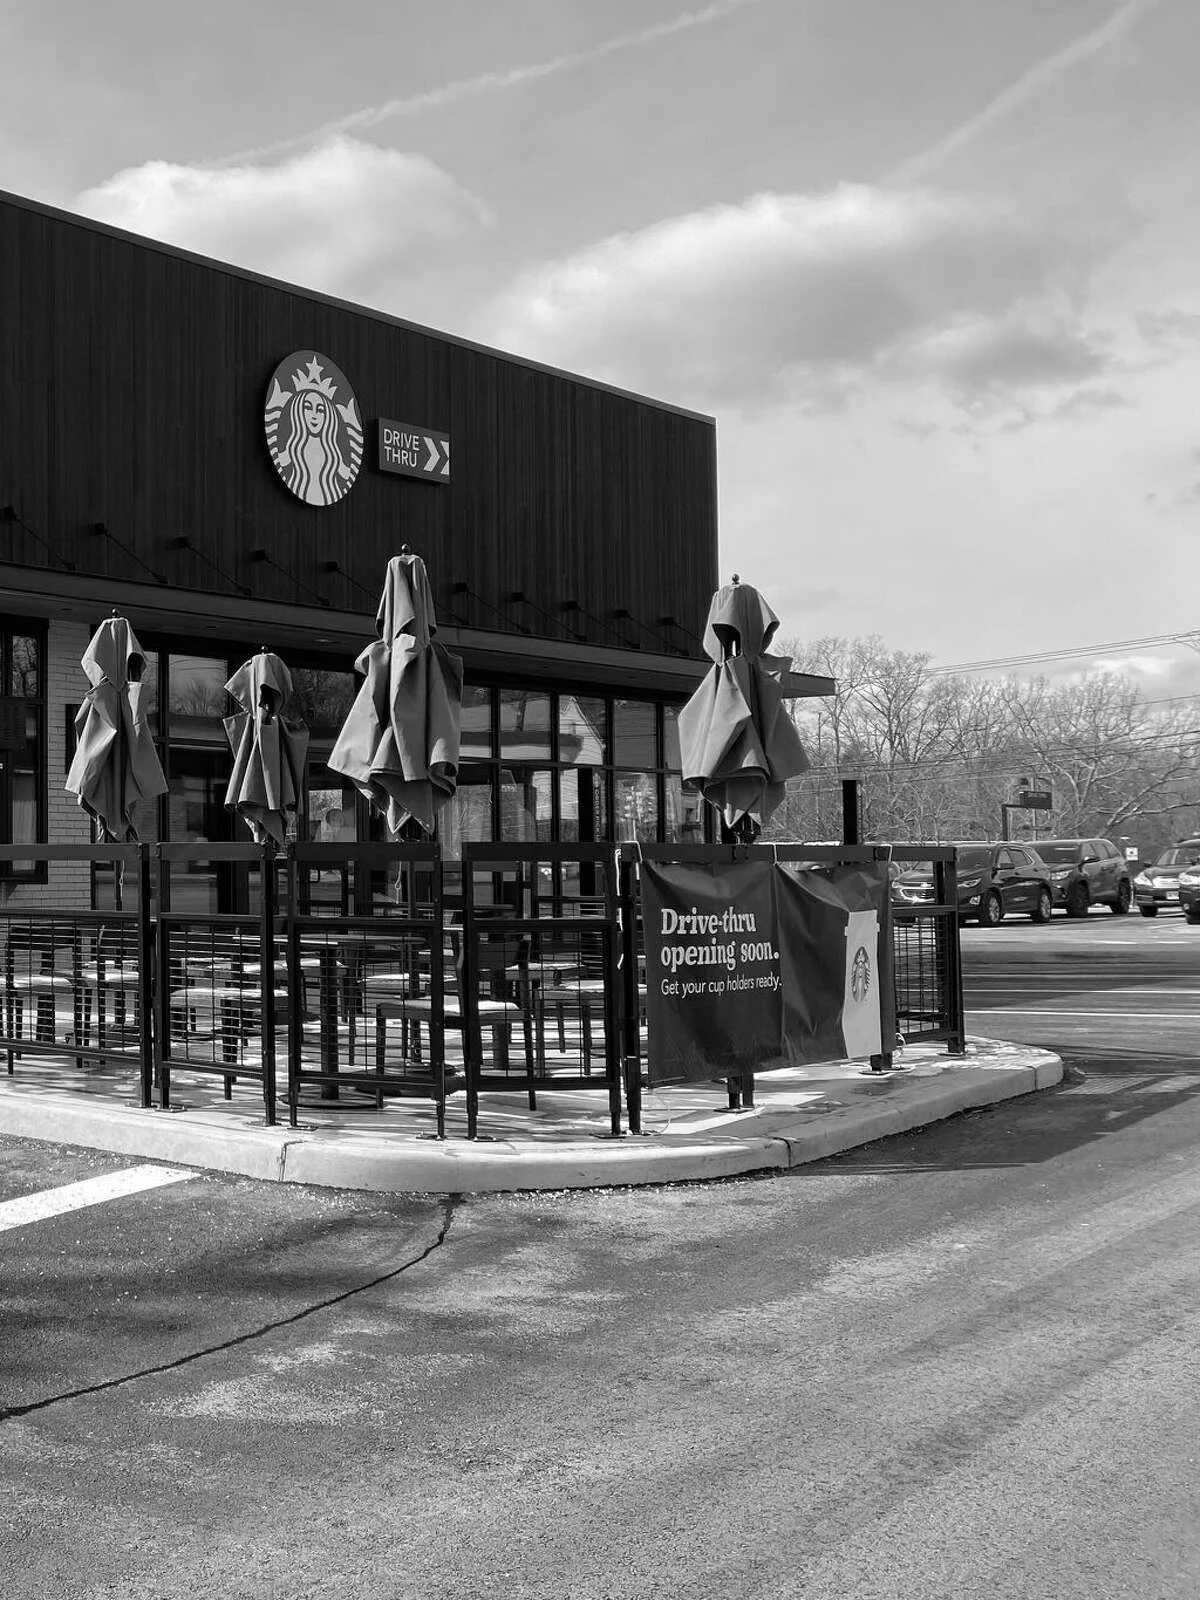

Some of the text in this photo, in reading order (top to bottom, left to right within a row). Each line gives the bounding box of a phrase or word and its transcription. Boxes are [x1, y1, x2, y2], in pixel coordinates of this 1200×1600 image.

[384, 428, 420, 451] DRIVE
[384, 446, 417, 467] THRU
[661, 906, 756, 934] Drive-thru
[661, 937, 780, 972] opening soon.
[661, 971, 782, 999] Get your cup holders ready.
